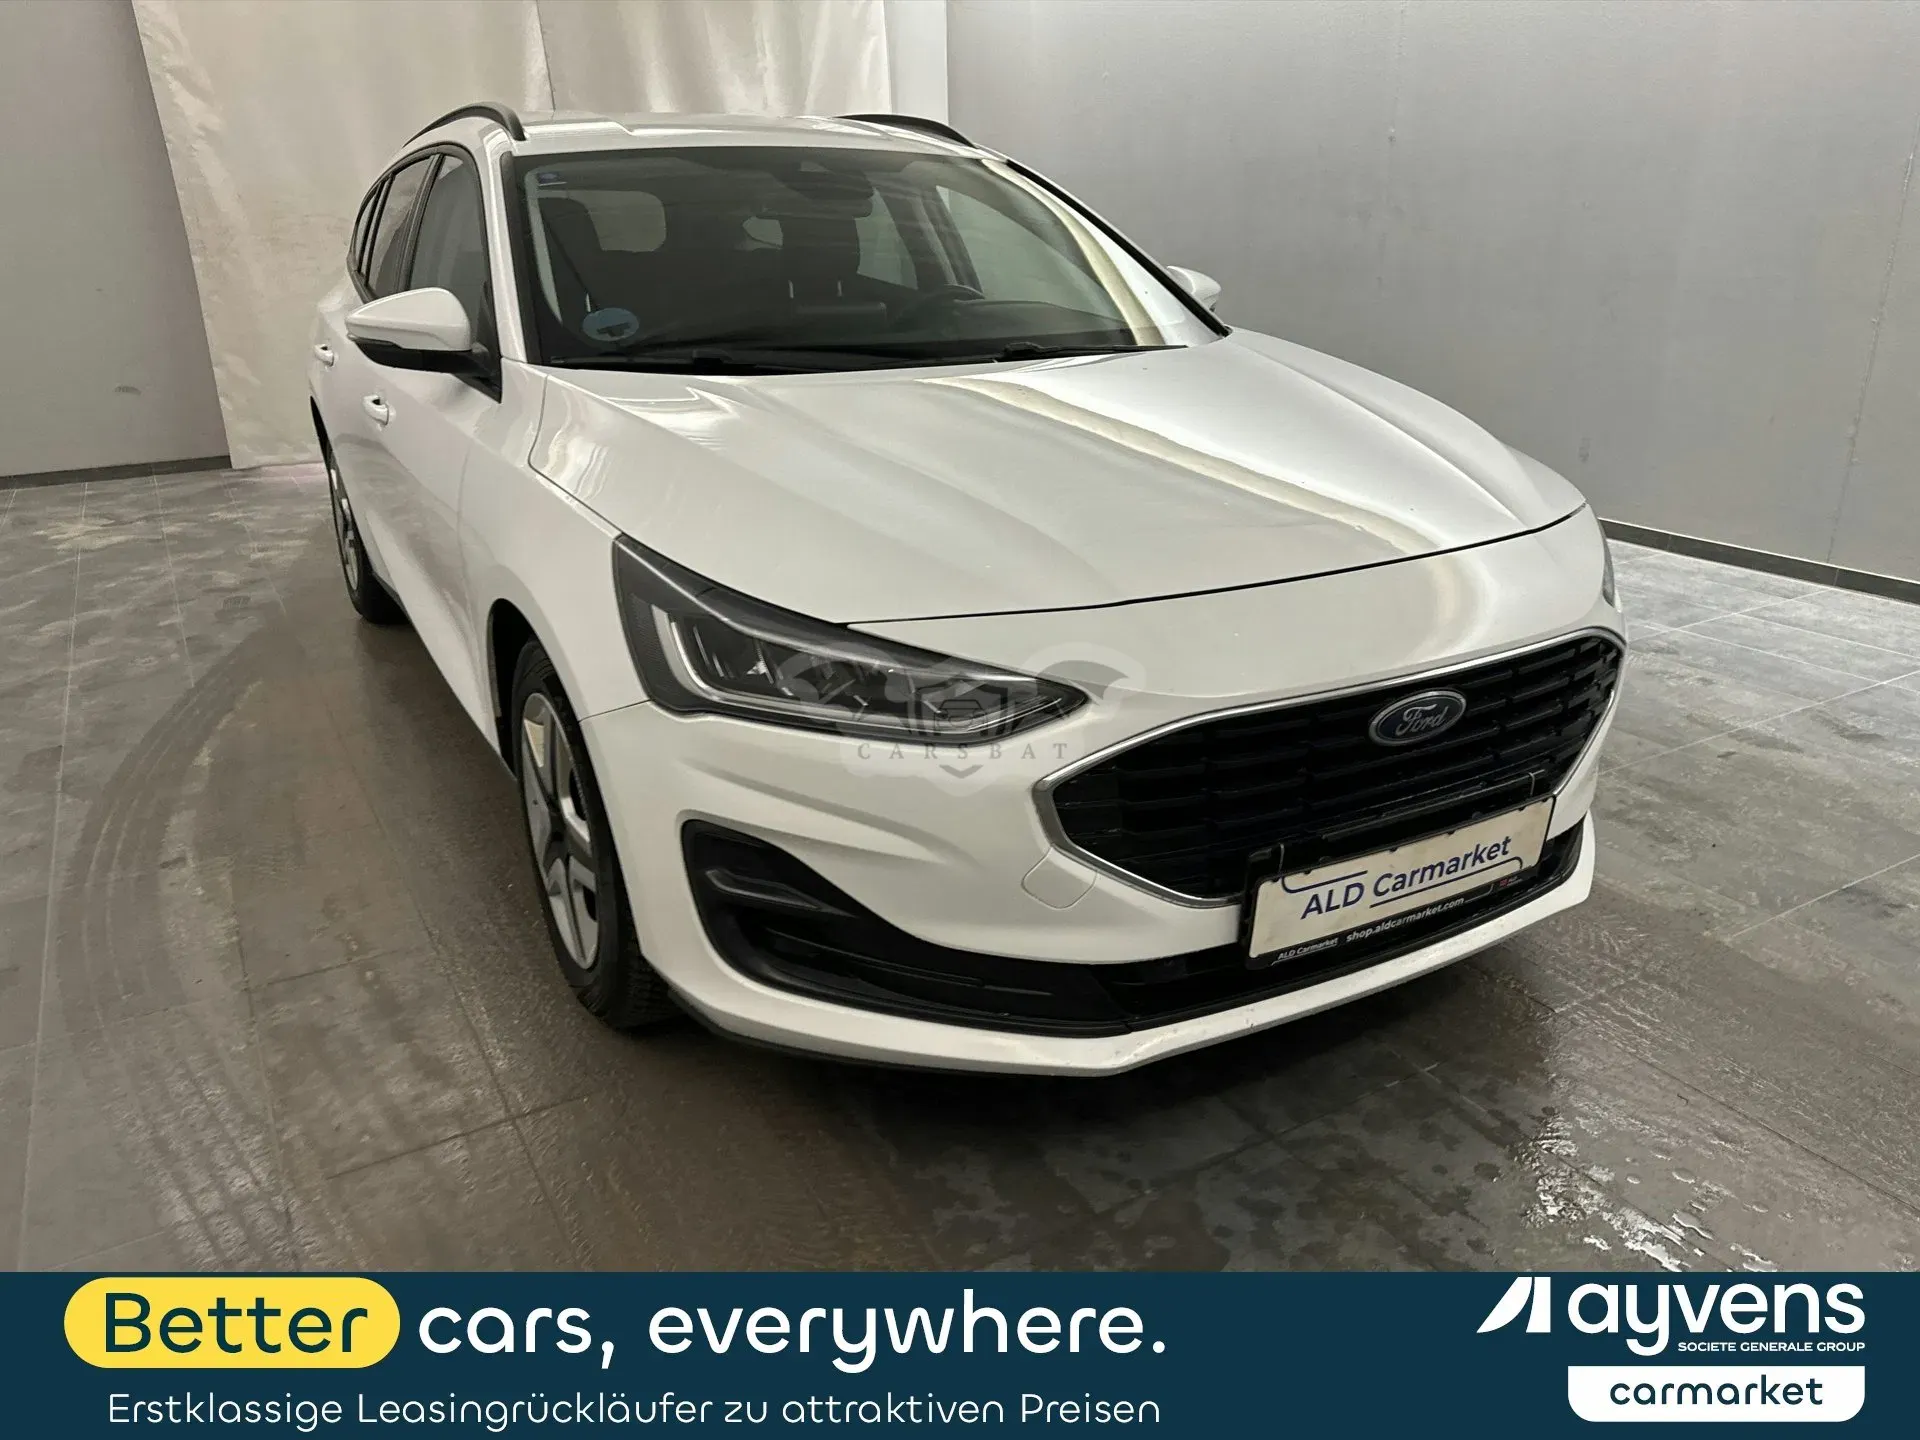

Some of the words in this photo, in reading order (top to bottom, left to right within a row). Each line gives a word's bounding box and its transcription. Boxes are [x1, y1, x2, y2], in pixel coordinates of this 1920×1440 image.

[1395, 703, 1449, 736] Ford
[1301, 882, 1365, 920] ALD
[1372, 835, 1512, 898] Carmarket
[1346, 896, 1465, 944] shop.aldcarmarket.com
[1278, 948, 1296, 961] ALD
[1297, 937, 1339, 955] Carmarket
